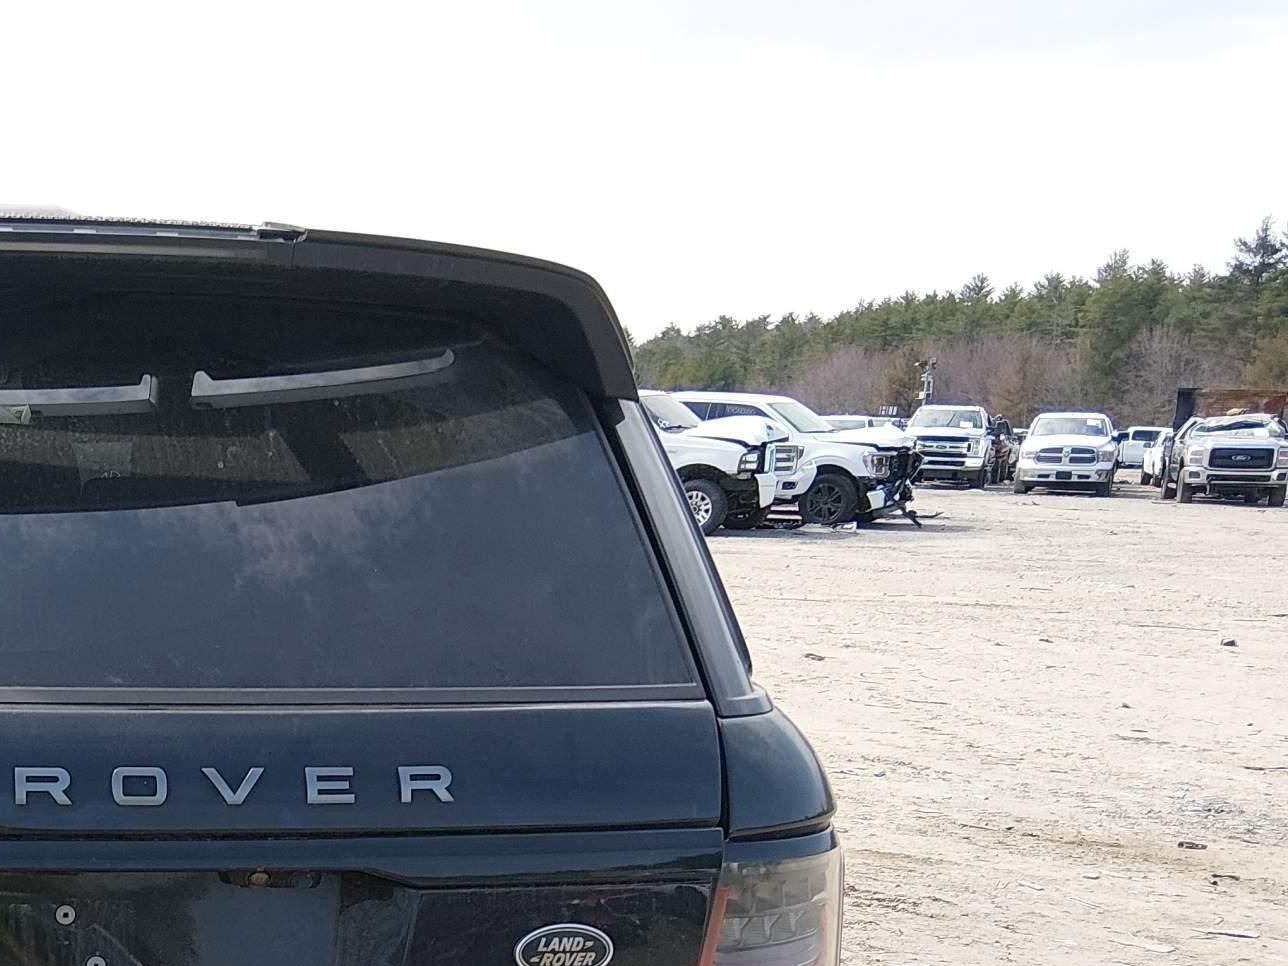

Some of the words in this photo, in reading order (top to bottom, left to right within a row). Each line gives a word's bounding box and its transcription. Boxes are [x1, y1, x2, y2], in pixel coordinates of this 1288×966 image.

[13, 764, 456, 807] ROVER
[538, 937, 585, 952] LAND
[540, 952, 596, 966] ROVER
